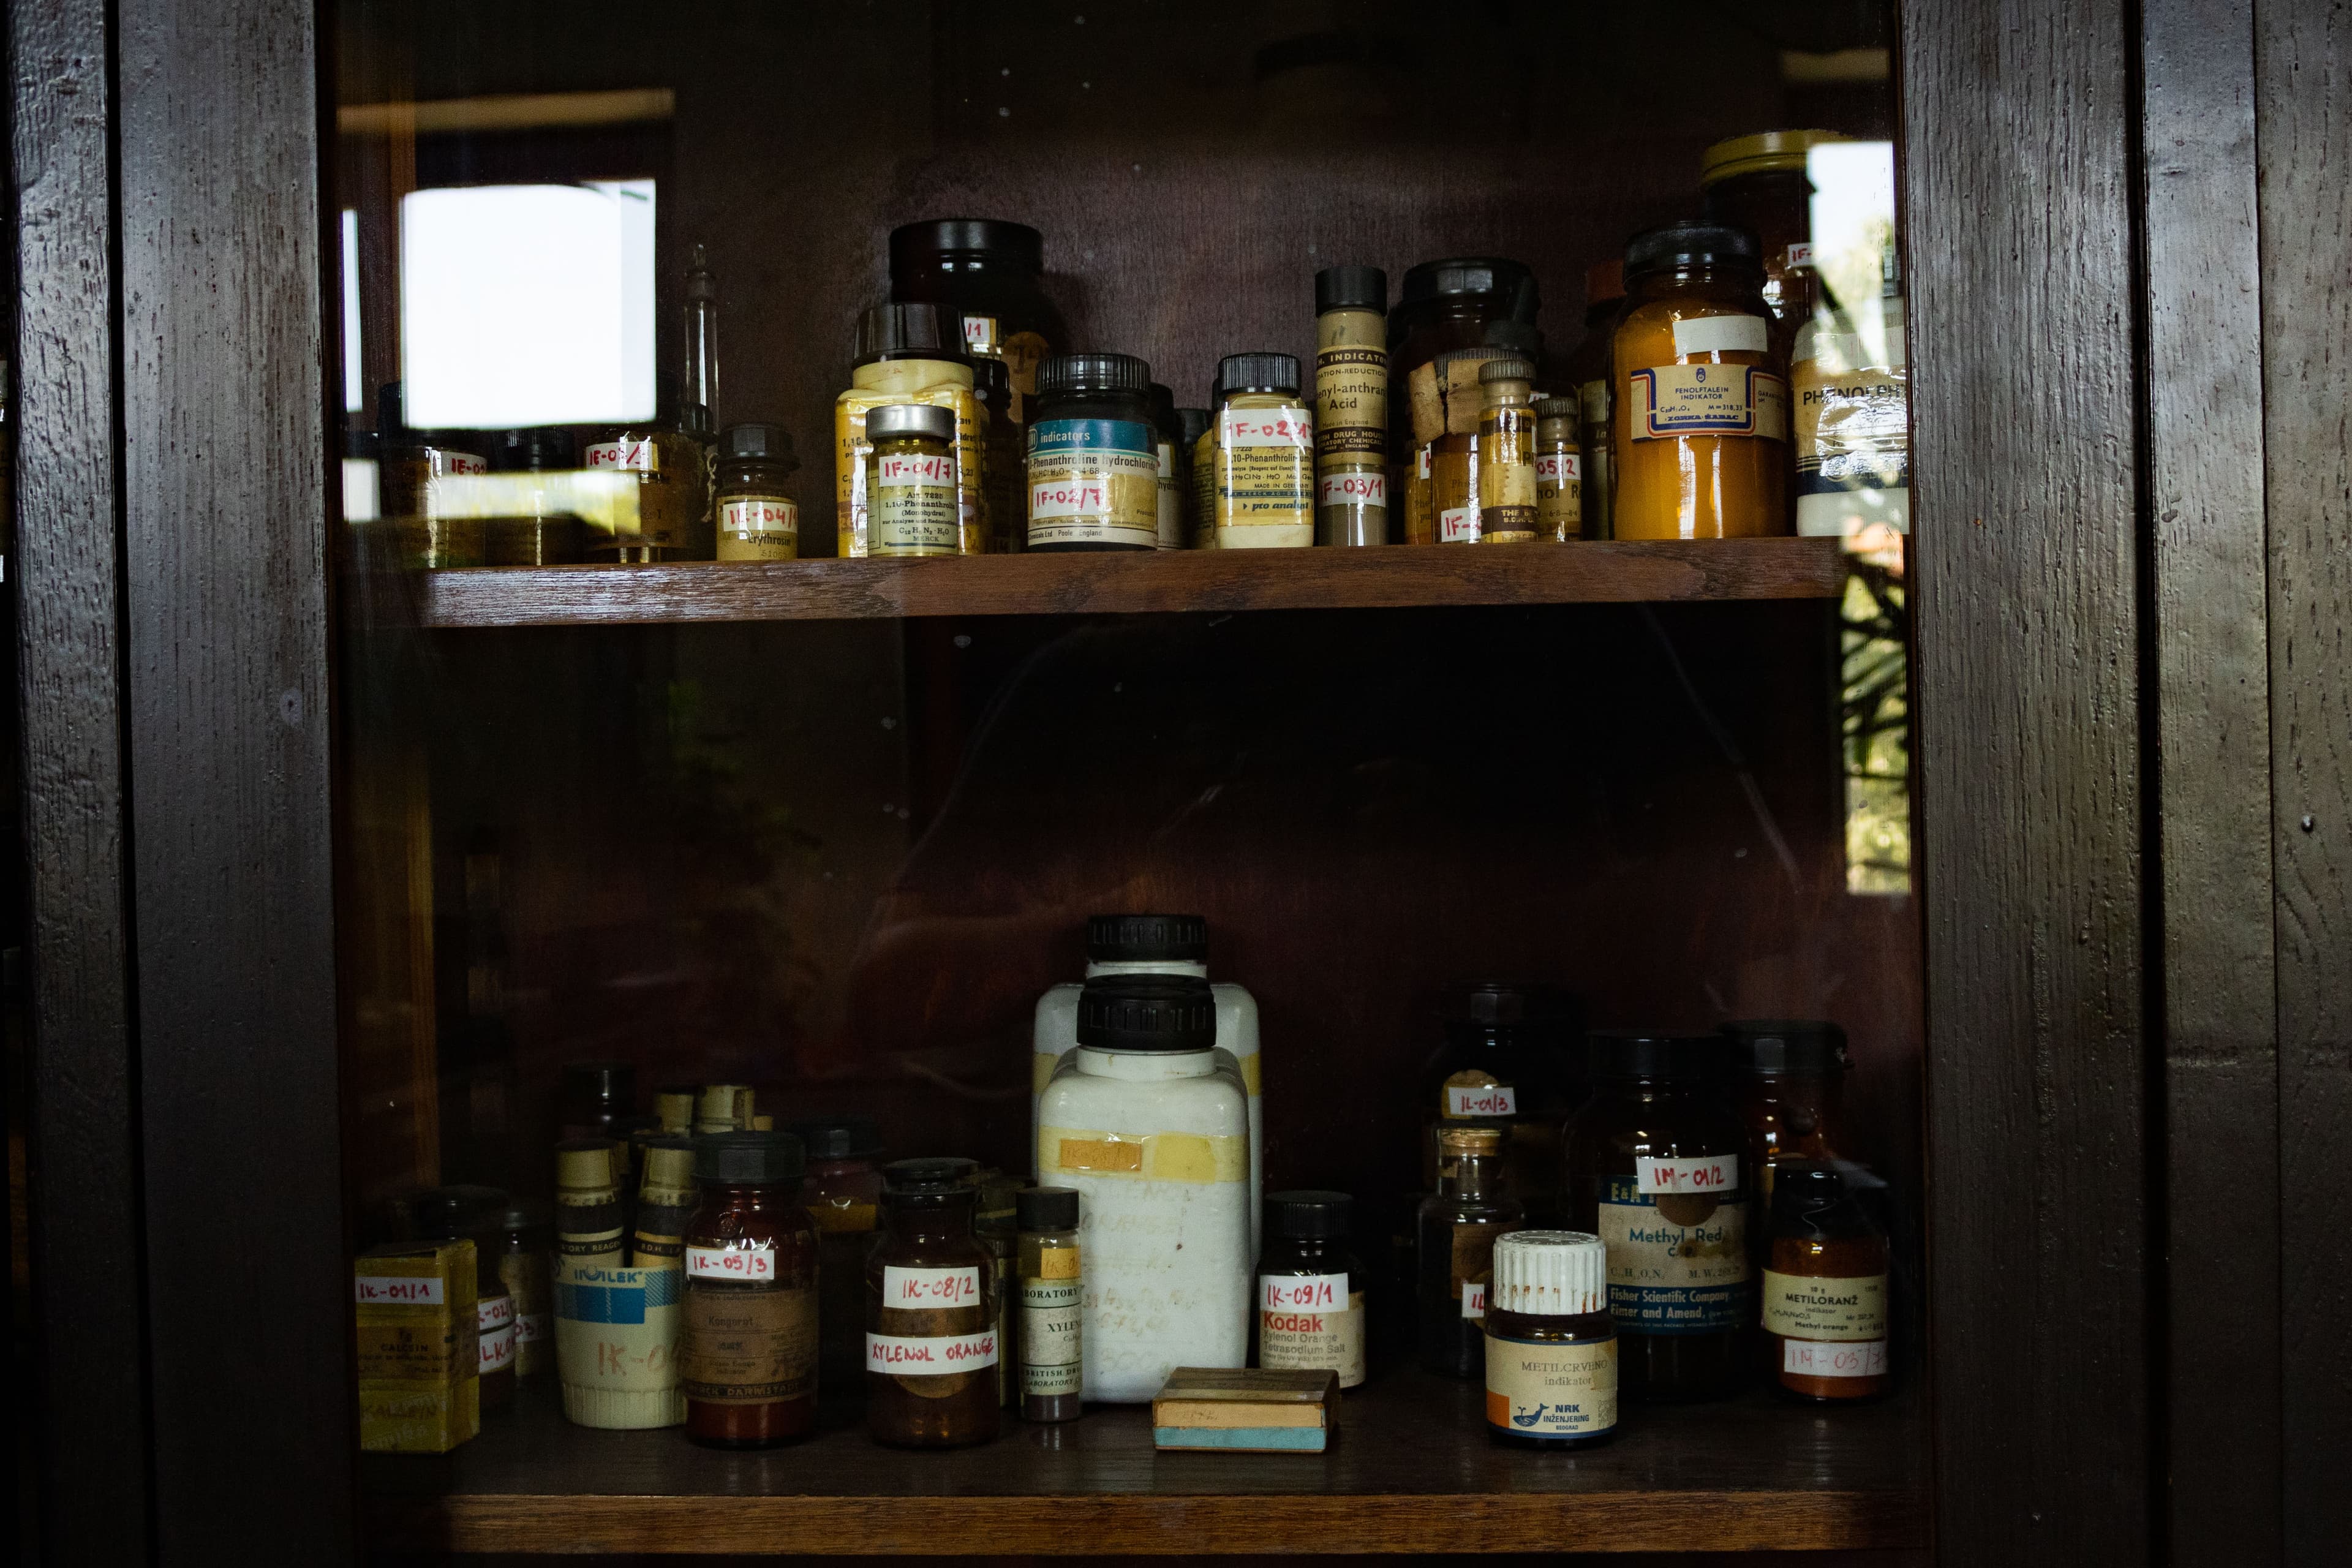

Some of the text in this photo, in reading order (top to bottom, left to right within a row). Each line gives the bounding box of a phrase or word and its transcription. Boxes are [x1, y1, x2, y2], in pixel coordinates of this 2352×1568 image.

[1329, 398, 1357, 411] Acid
[1041, 431, 1091, 443] indicators
[748, 531, 791, 547] Erythrosin
[1079, 529, 1102, 538] England
[1629, 1227, 1685, 1246] Methyl
[903, 1276, 975, 1302] IK-08/2
[1267, 1281, 1333, 1308] IK-09/1
[1610, 1287, 1640, 1302] Fisher
[1642, 1289, 1686, 1303] Scientific
[1785, 1292, 1859, 1305] METILORANŽ
[1642, 1306, 1663, 1319] and
[1264, 1311, 1324, 1333] Kodak
[1795, 1321, 1821, 1330] Methyl
[1823, 1322, 1849, 1332] orange
[1264, 1330, 1338, 1344] Xylenol Orange
[872, 1342, 935, 1363] XYLENOL
[1264, 1341, 1346, 1354] Tetrasodium Salt
[1521, 1359, 1608, 1373] METILCRVENO
[1544, 1376, 1592, 1386] indikator
[1555, 1404, 1580, 1413] NRK
[1544, 1414, 1590, 1423] INŽENJERING
